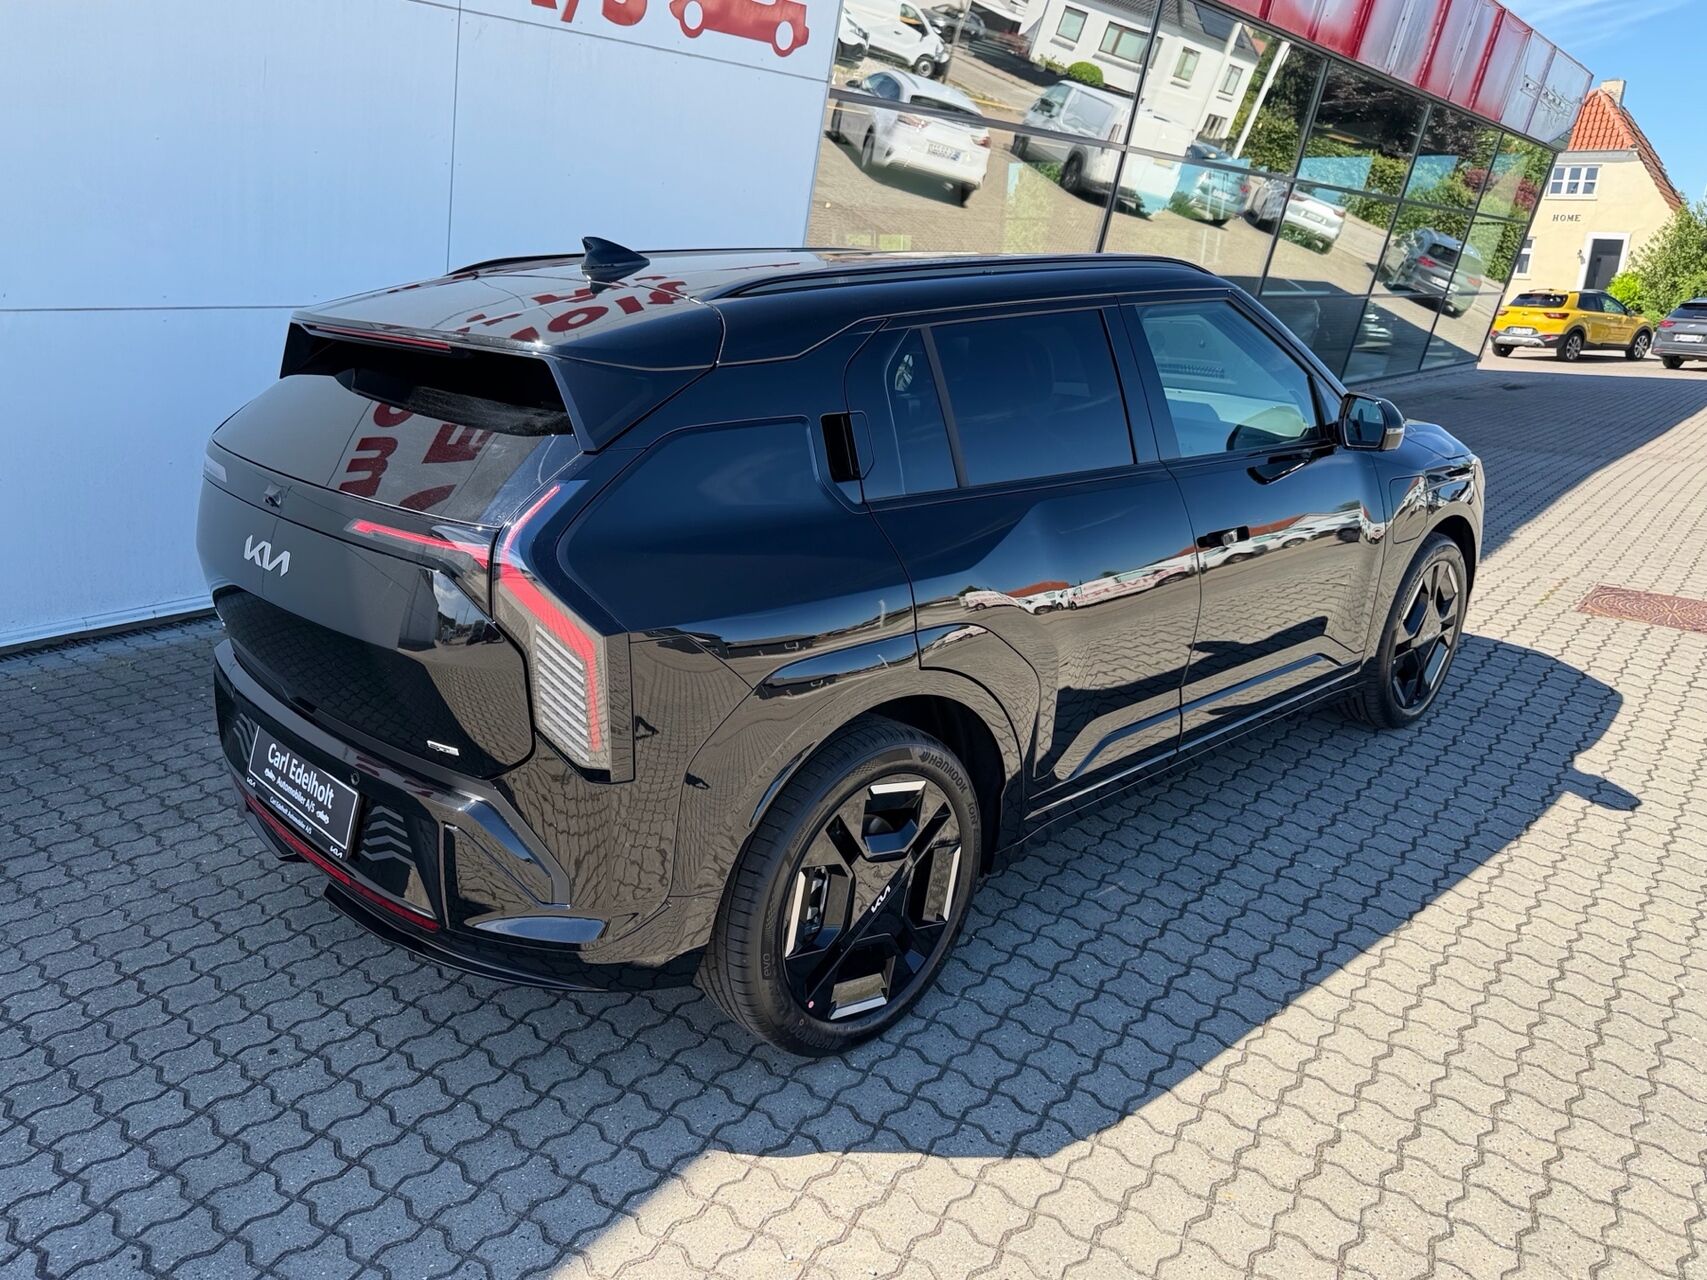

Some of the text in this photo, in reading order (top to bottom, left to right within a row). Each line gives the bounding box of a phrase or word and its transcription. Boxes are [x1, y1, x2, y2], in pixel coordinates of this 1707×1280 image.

[1552, 214, 1582, 222] HOME
[243, 535, 291, 577] KIA
[267, 742, 335, 810] Carl Edelholt
[275, 776, 316, 813] Automobiler A/S
[870, 885, 891, 913] KIA
